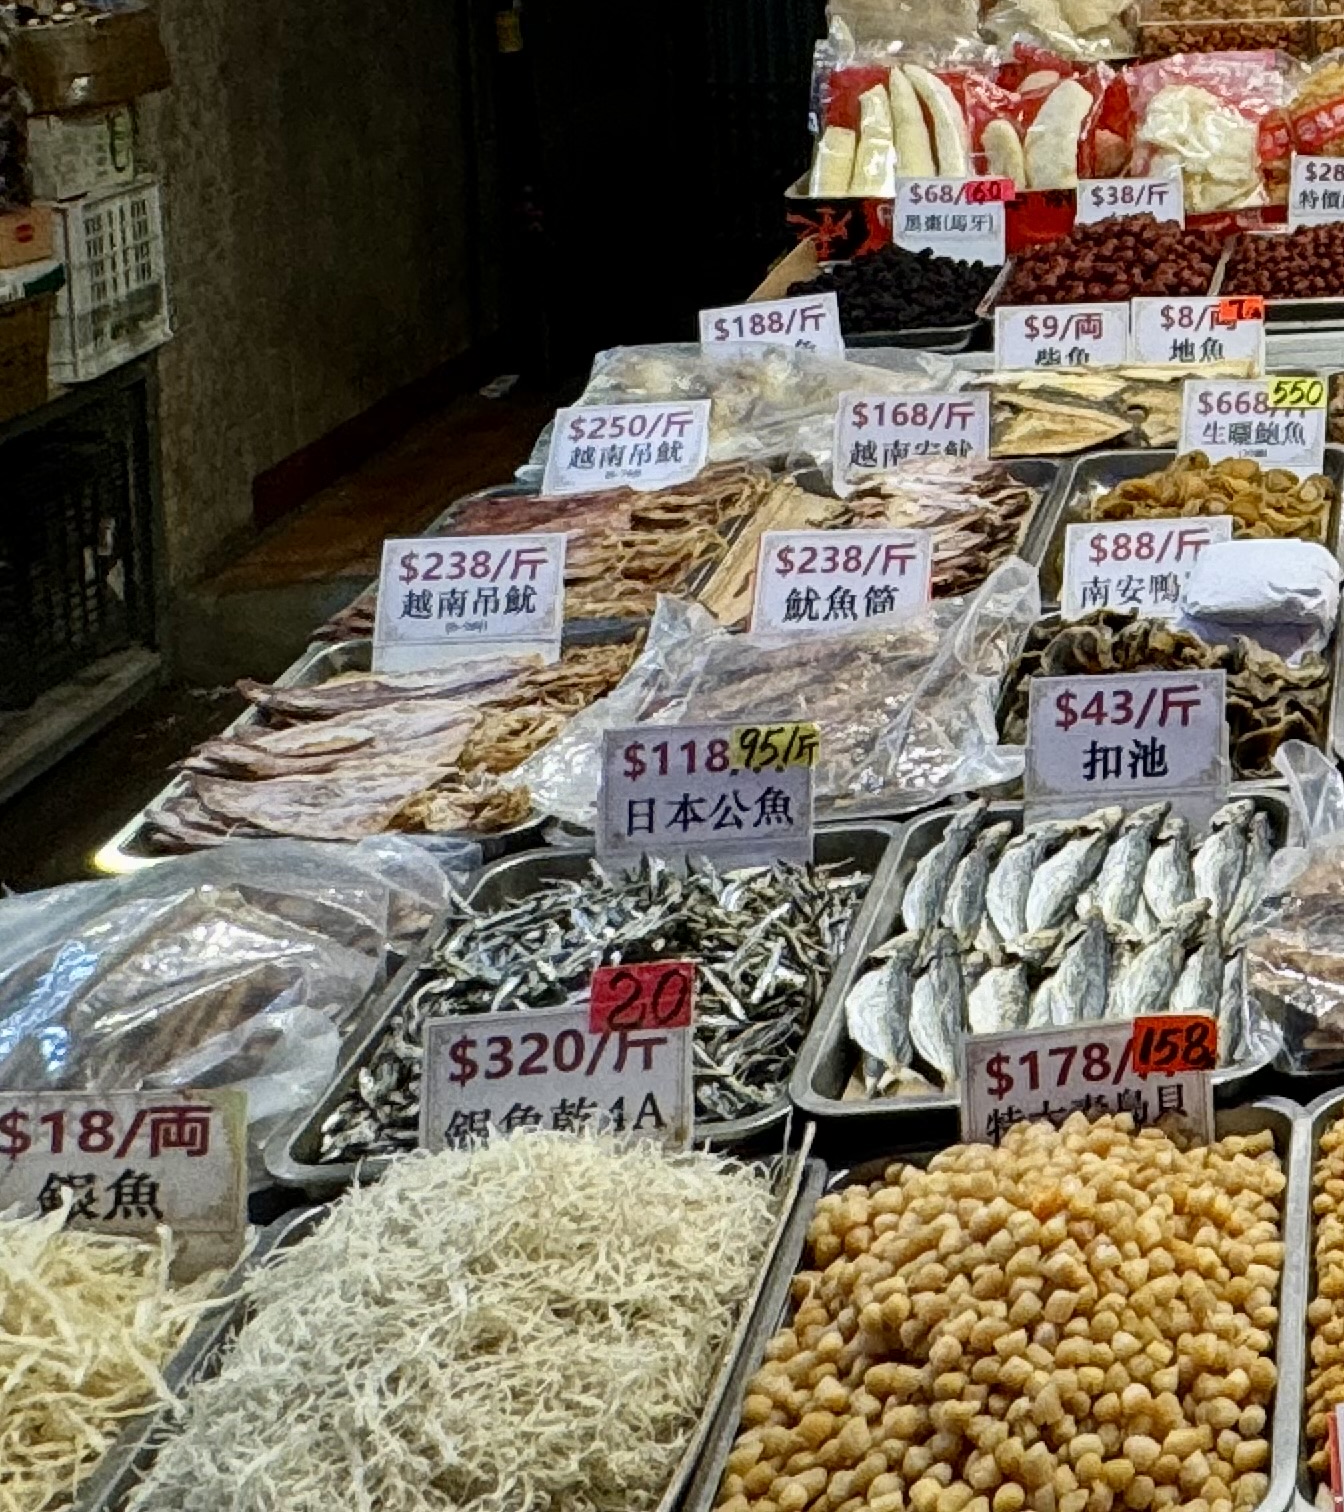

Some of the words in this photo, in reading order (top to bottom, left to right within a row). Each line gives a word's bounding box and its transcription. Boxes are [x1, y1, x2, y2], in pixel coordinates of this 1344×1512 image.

[1090, 182, 1170, 207] $38/斤
[714, 303, 826, 341] $188/斤
[1272, 379, 1324, 406] 550
[567, 410, 694, 443] $250/斤
[851, 400, 975, 431] $168/斤
[399, 546, 549, 585] $238/斤
[775, 543, 917, 577] $238/斤
[1088, 528, 1211, 566] $88/斤
[1055, 684, 1202, 731] $43/斤
[1082, 736, 1168, 782] 扣池
[625, 786, 795, 837] 日本公魚
[449, 1026, 669, 1087] $320/斤
[36, 1168, 165, 1221] 銀魚
